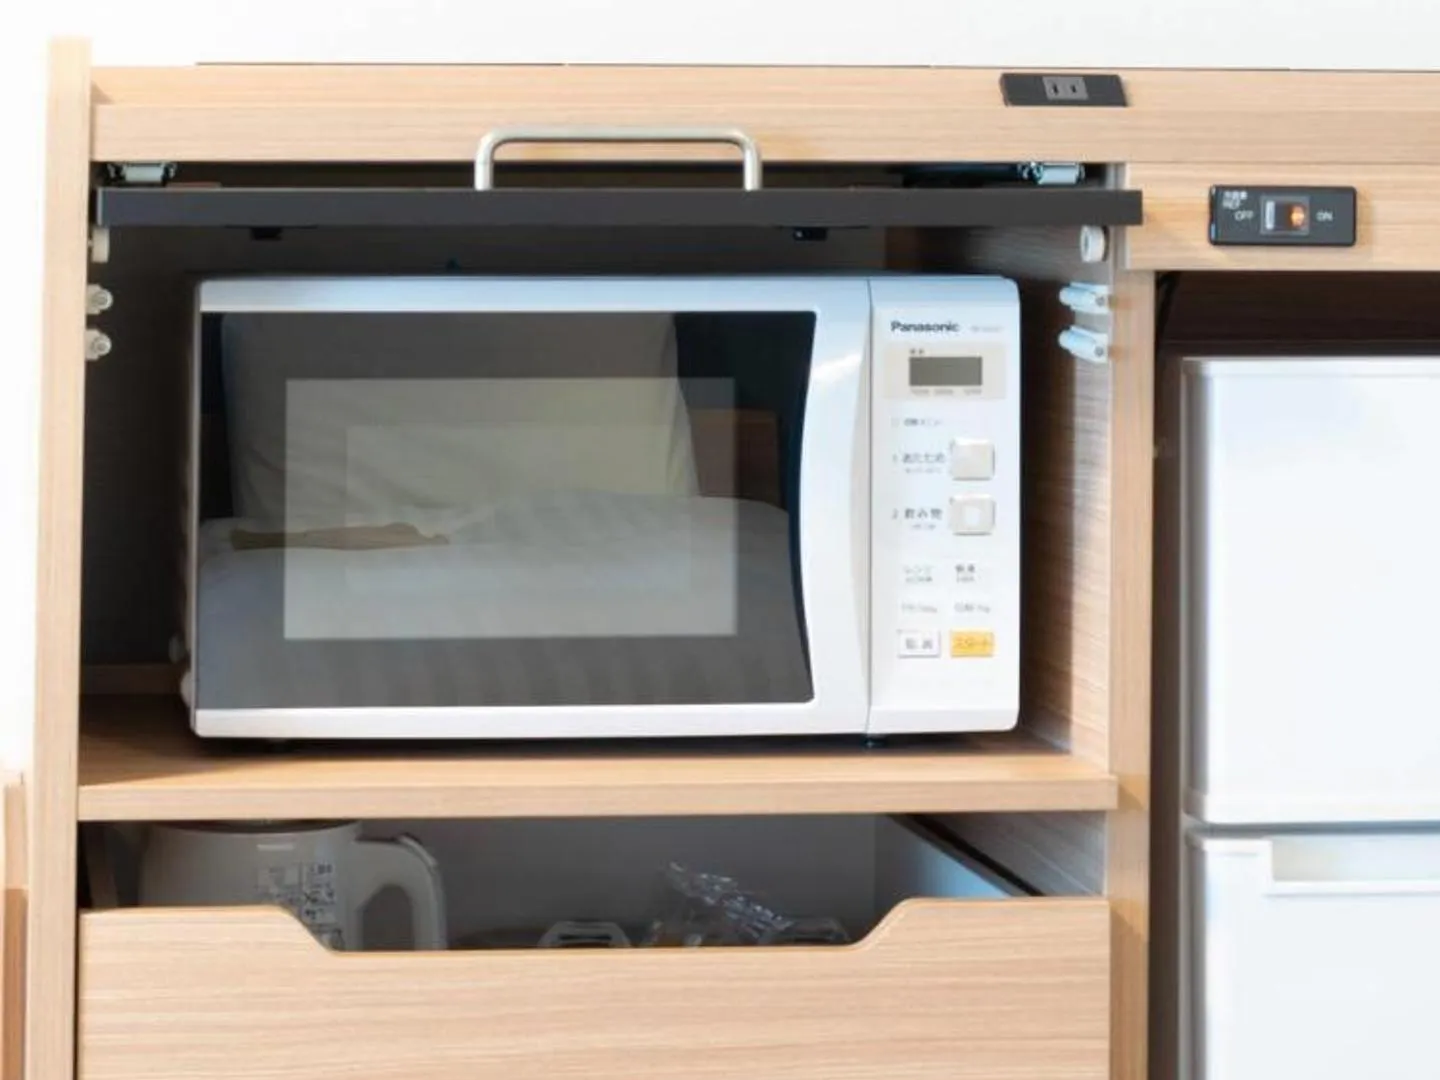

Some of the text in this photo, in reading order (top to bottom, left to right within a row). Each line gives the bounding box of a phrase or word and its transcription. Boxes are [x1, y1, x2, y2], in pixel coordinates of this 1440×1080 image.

[1234, 210, 1254, 221] OFF
[1316, 212, 1333, 221] ON
[890, 321, 960, 332] Panasonic
